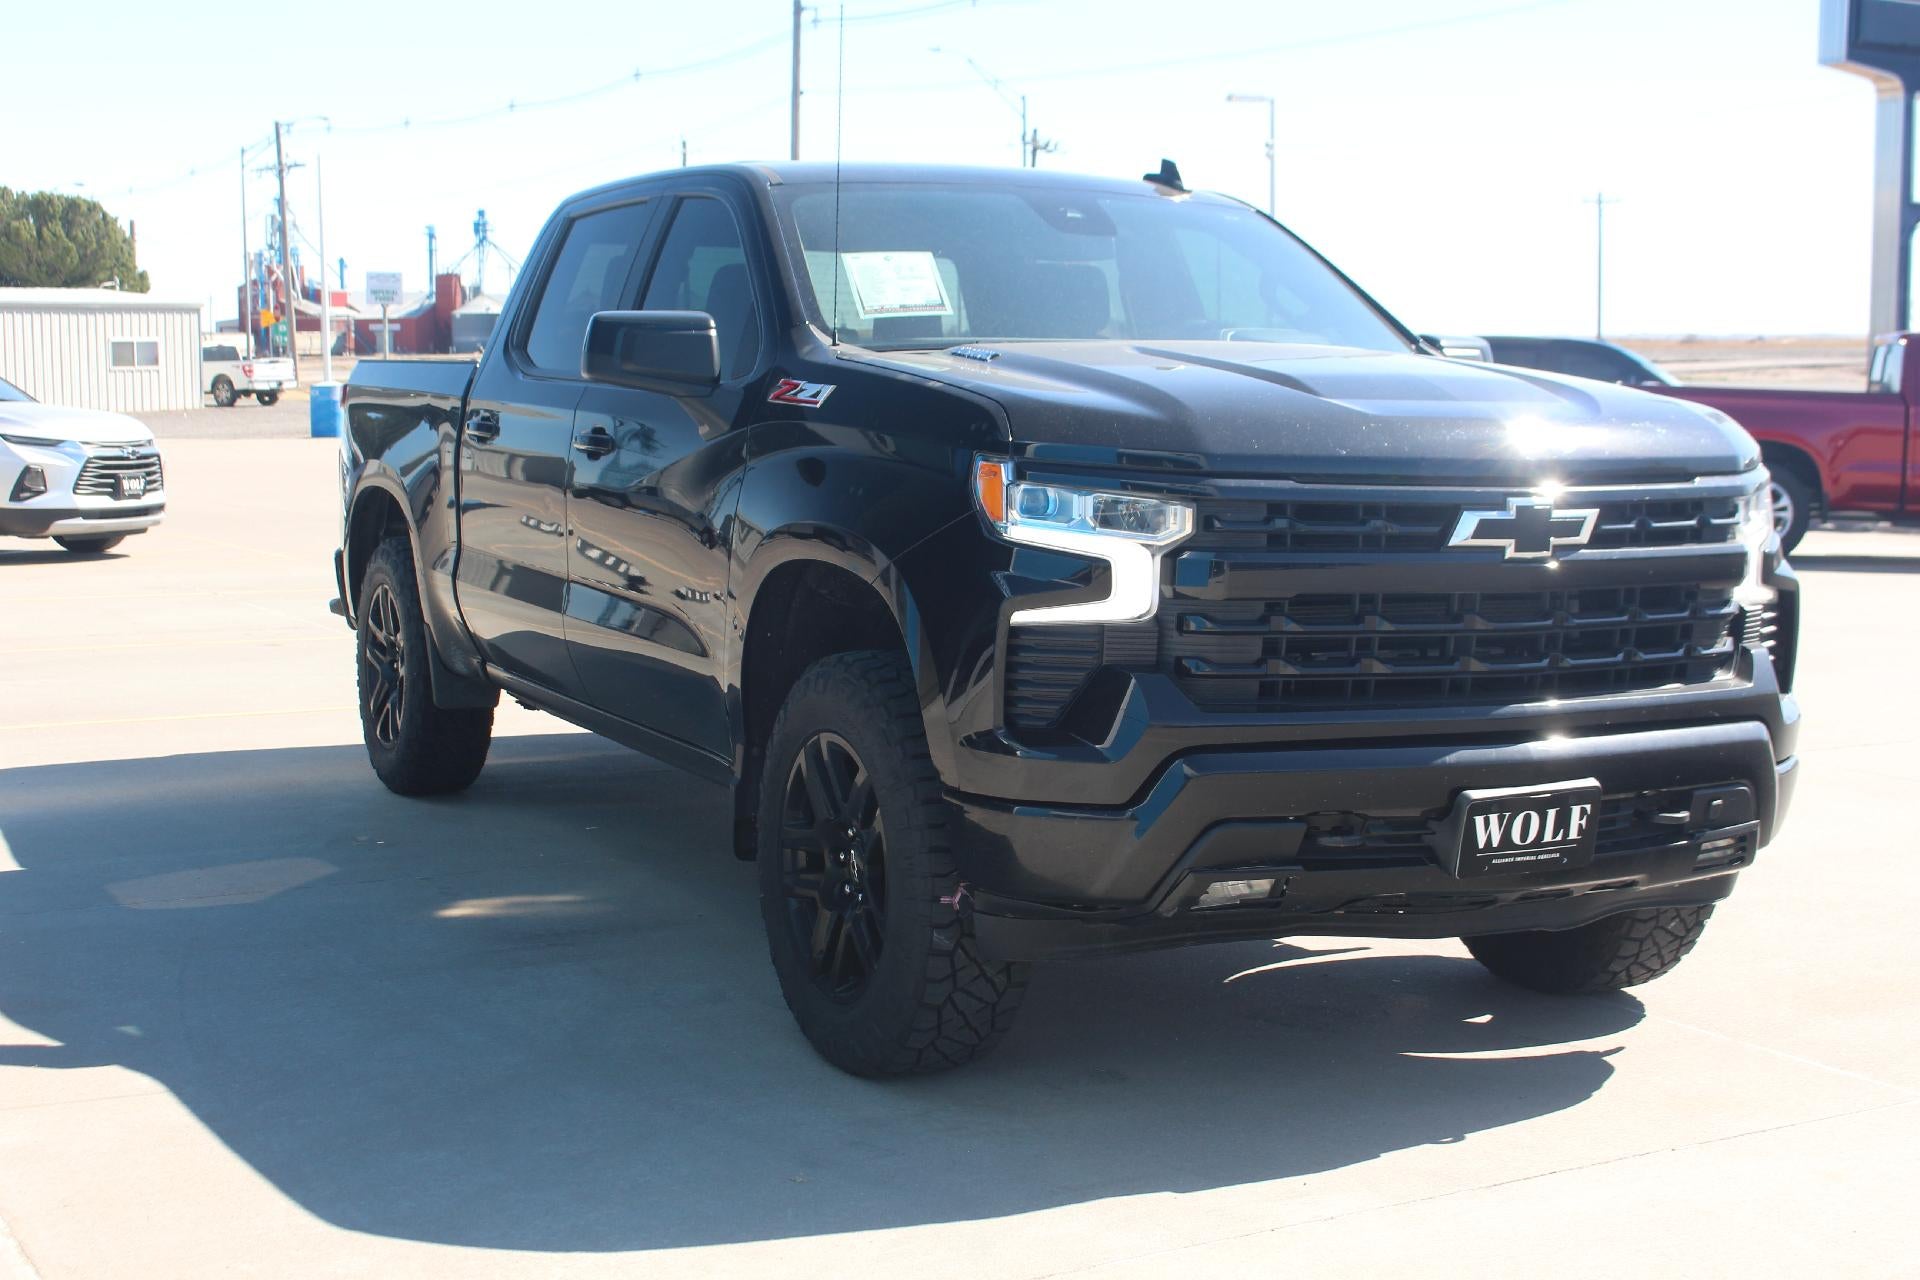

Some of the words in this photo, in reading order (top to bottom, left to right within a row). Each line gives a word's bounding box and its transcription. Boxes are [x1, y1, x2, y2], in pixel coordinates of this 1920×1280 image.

[767, 378, 838, 409] Z71
[122, 478, 146, 490] WOLF
[1473, 803, 1592, 849] WOLF
